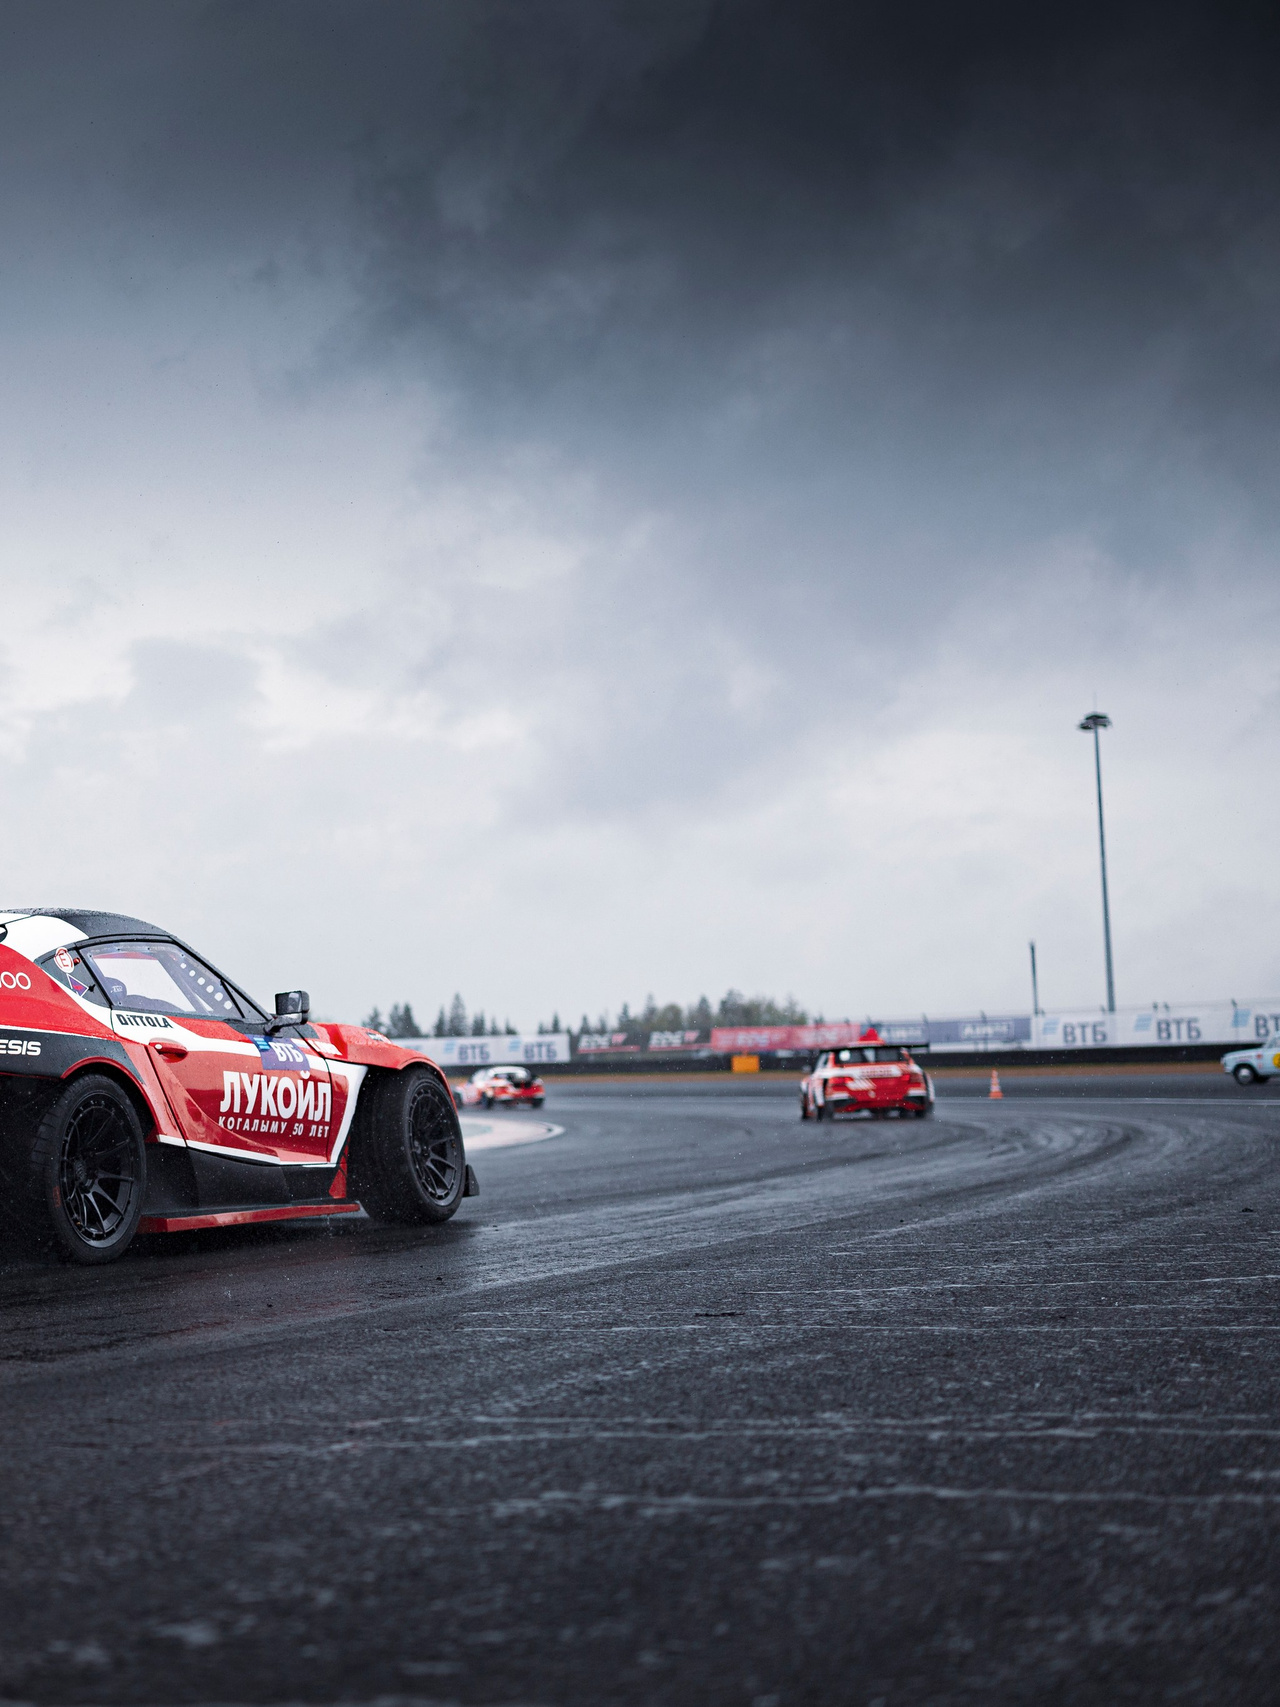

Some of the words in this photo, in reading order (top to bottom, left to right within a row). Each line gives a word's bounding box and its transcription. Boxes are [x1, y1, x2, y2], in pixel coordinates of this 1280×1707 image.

[1062, 1021, 1108, 1044] ВТБ
[1157, 1017, 1202, 1041] ВТБ
[1255, 1014, 1280, 1038] ВТ
[268, 1041, 304, 1063] ВТБ
[458, 1043, 490, 1063] ВТБ
[524, 1042, 557, 1062] ВТБ
[219, 1070, 332, 1123] ЛУКОЙЛ
[218, 1115, 288, 1135] КОГАЛЫМУ
[292, 1123, 304, 1136] 50
[308, 1125, 330, 1138] ЛЕТ
